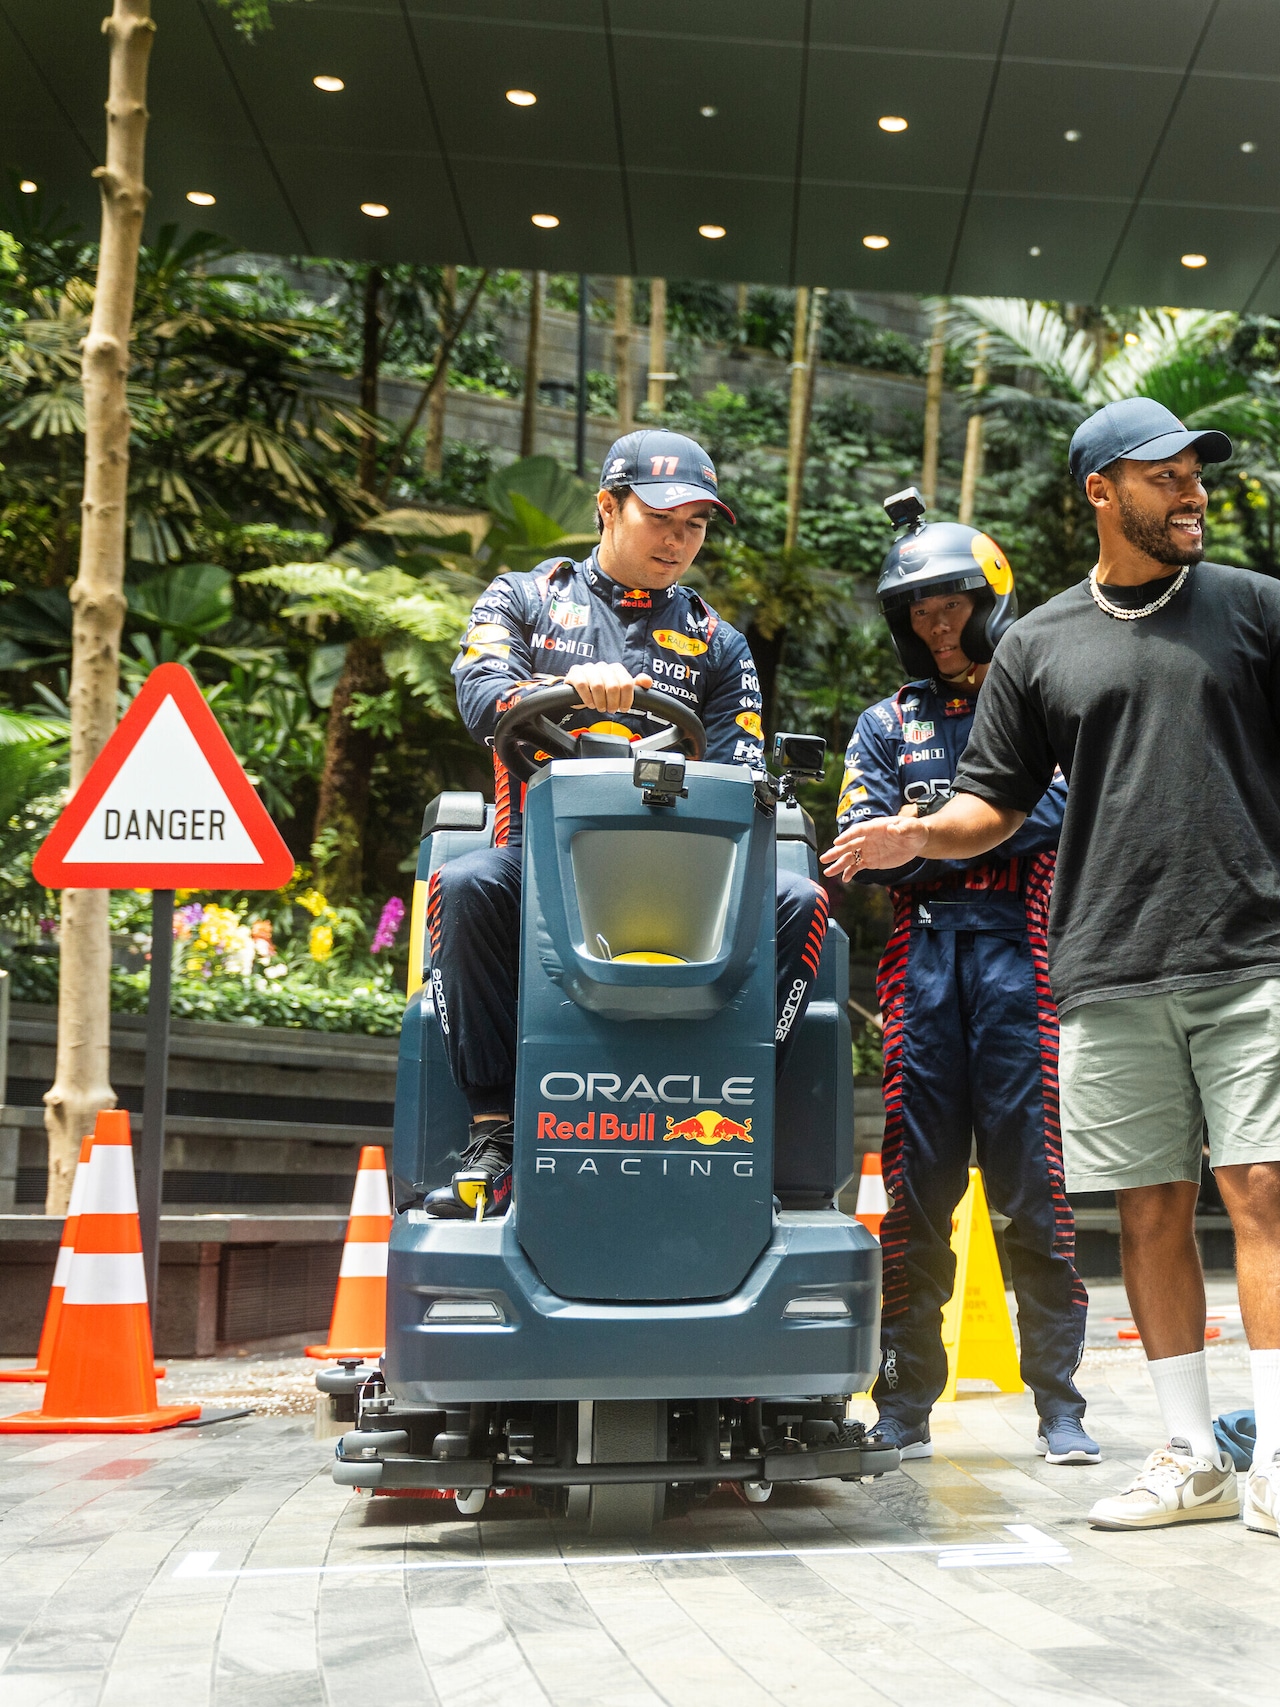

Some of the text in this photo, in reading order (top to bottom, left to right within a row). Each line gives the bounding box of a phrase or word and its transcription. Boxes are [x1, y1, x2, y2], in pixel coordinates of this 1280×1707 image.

[650, 455, 680, 476] 11
[621, 600, 652, 609] Red Bull
[531, 633, 577, 654] Mobil
[667, 634, 701, 652] RAUCH
[652, 658, 701, 686] BYBIT
[741, 673, 760, 692] RO
[652, 679, 700, 704] HONDA
[104, 809, 226, 841] DANGER
[539, 1071, 756, 1105] ORACLE
[537, 1111, 656, 1142] Red Bull
[535, 1156, 754, 1178] RACING
